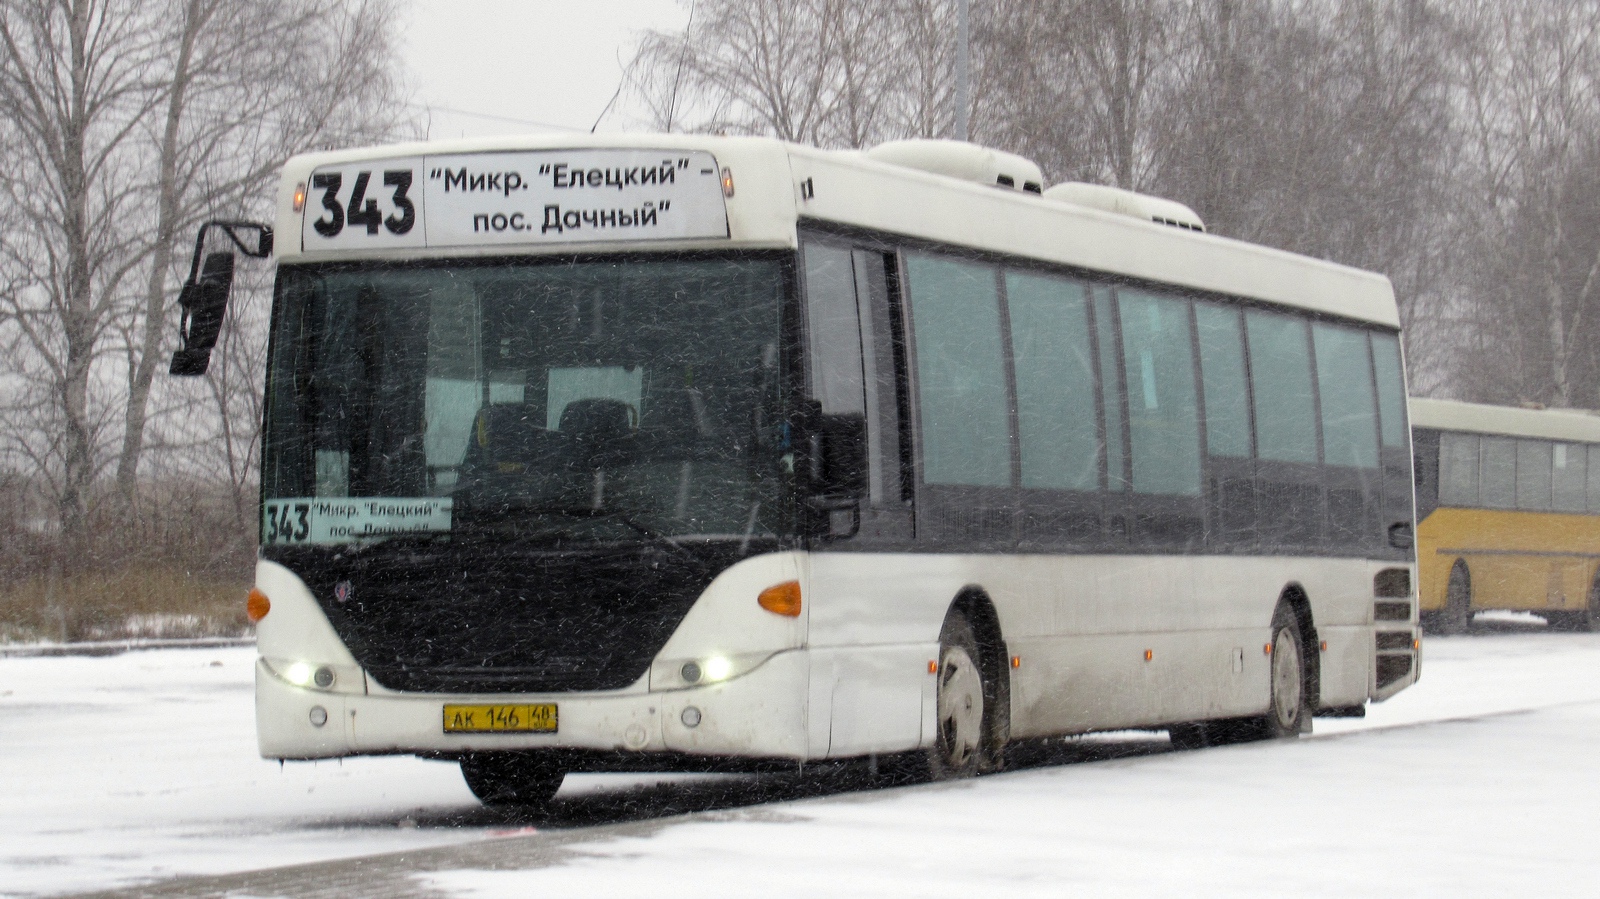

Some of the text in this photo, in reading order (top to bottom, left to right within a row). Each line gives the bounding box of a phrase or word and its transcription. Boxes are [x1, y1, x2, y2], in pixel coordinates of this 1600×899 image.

[430, 167, 528, 197] "Микр.
[538, 158, 690, 191] "Елецкий"
[313, 168, 415, 237] 343
[473, 200, 671, 234] пос. Дачный"
[267, 502, 310, 543] 343
[486, 706, 520, 728] 146
